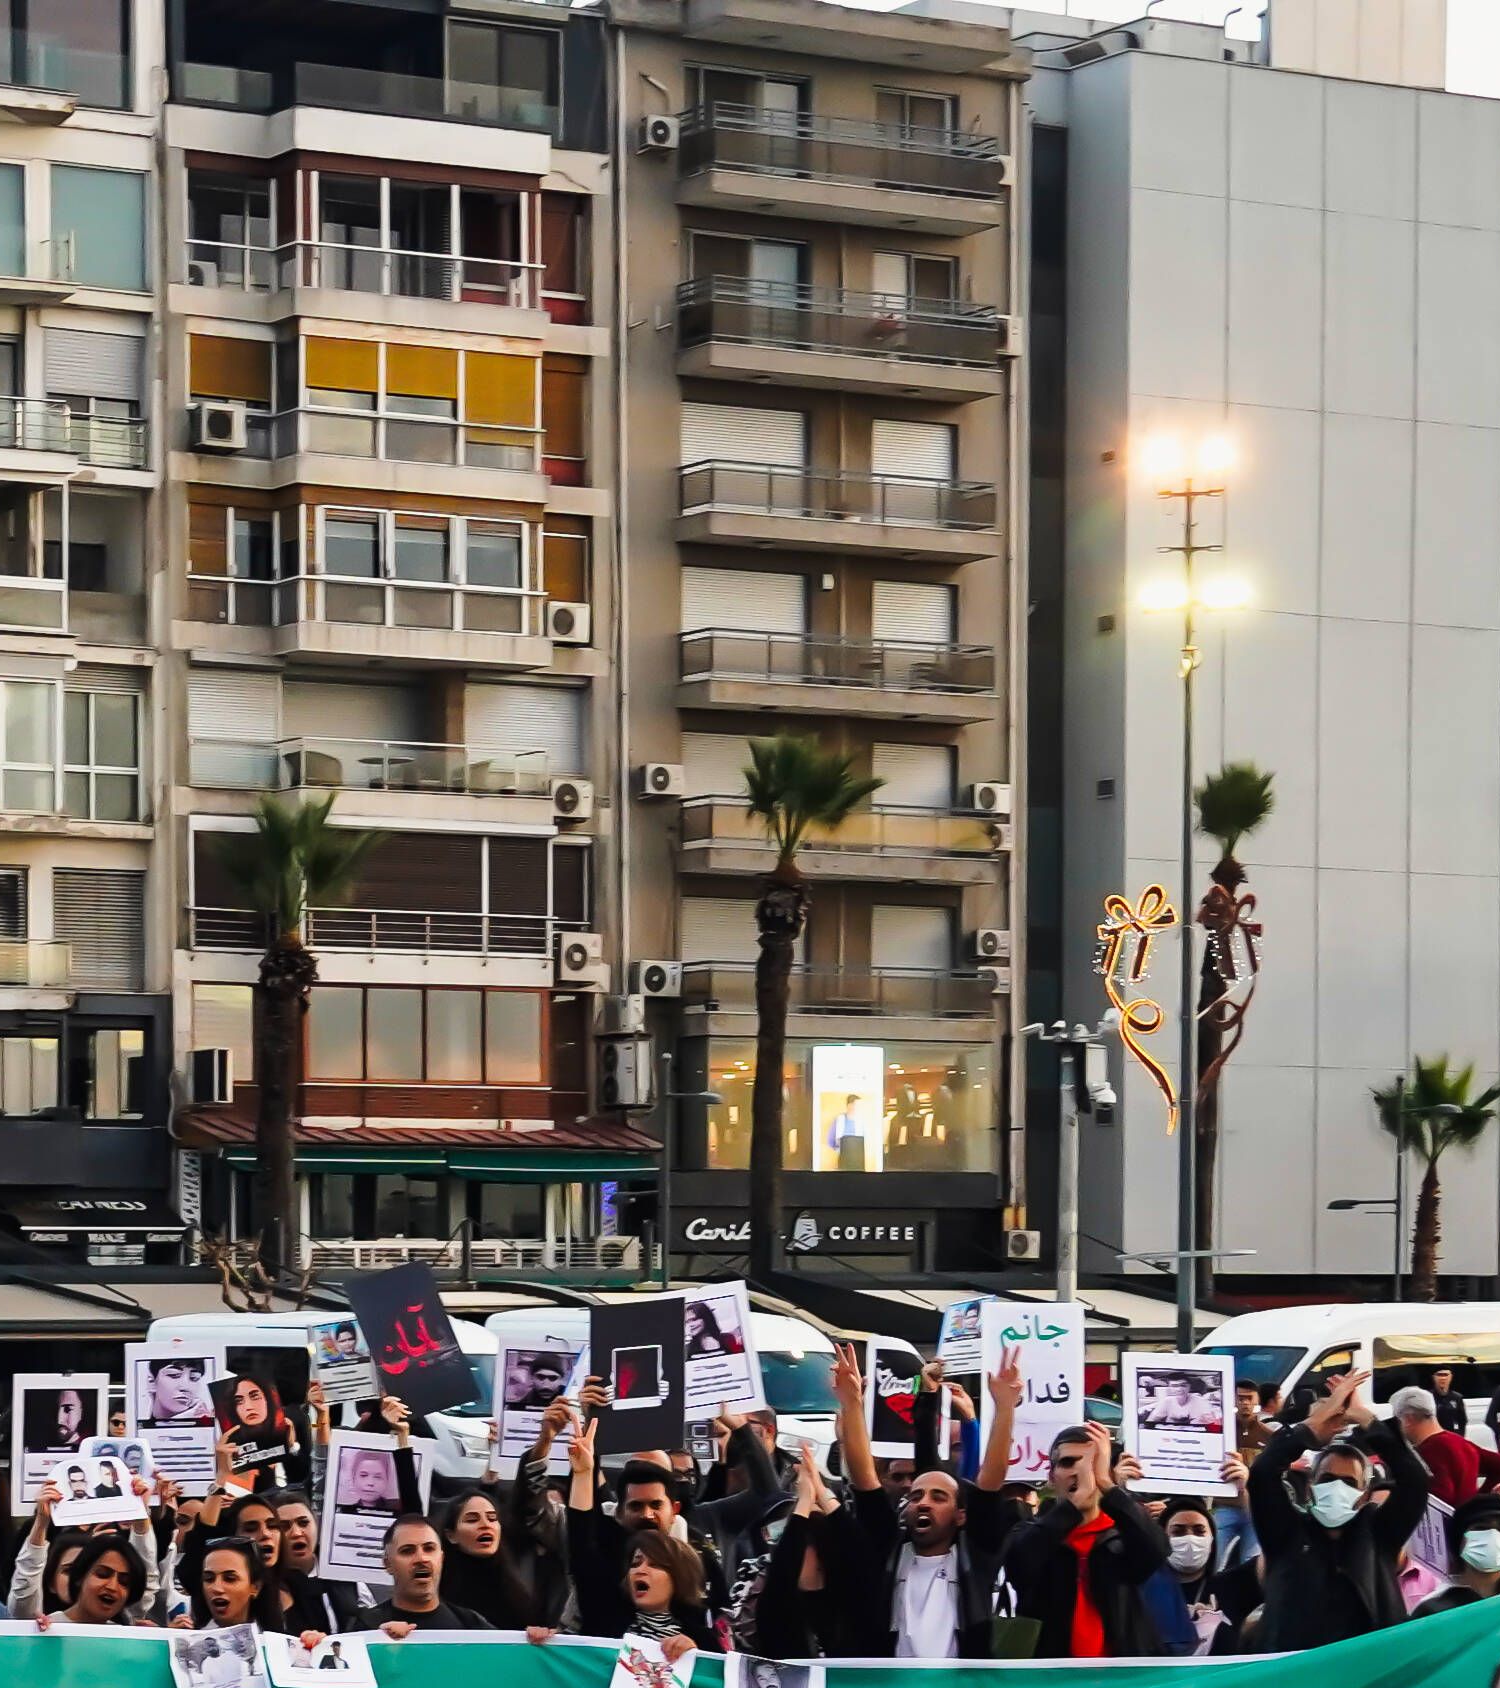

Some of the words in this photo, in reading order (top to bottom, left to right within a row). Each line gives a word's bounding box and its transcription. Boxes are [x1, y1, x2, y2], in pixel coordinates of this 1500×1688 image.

[685, 1217, 752, 1241] Cari
[829, 1221, 915, 1241] COFFEE
[1000, 1314, 1069, 1348] جانم
